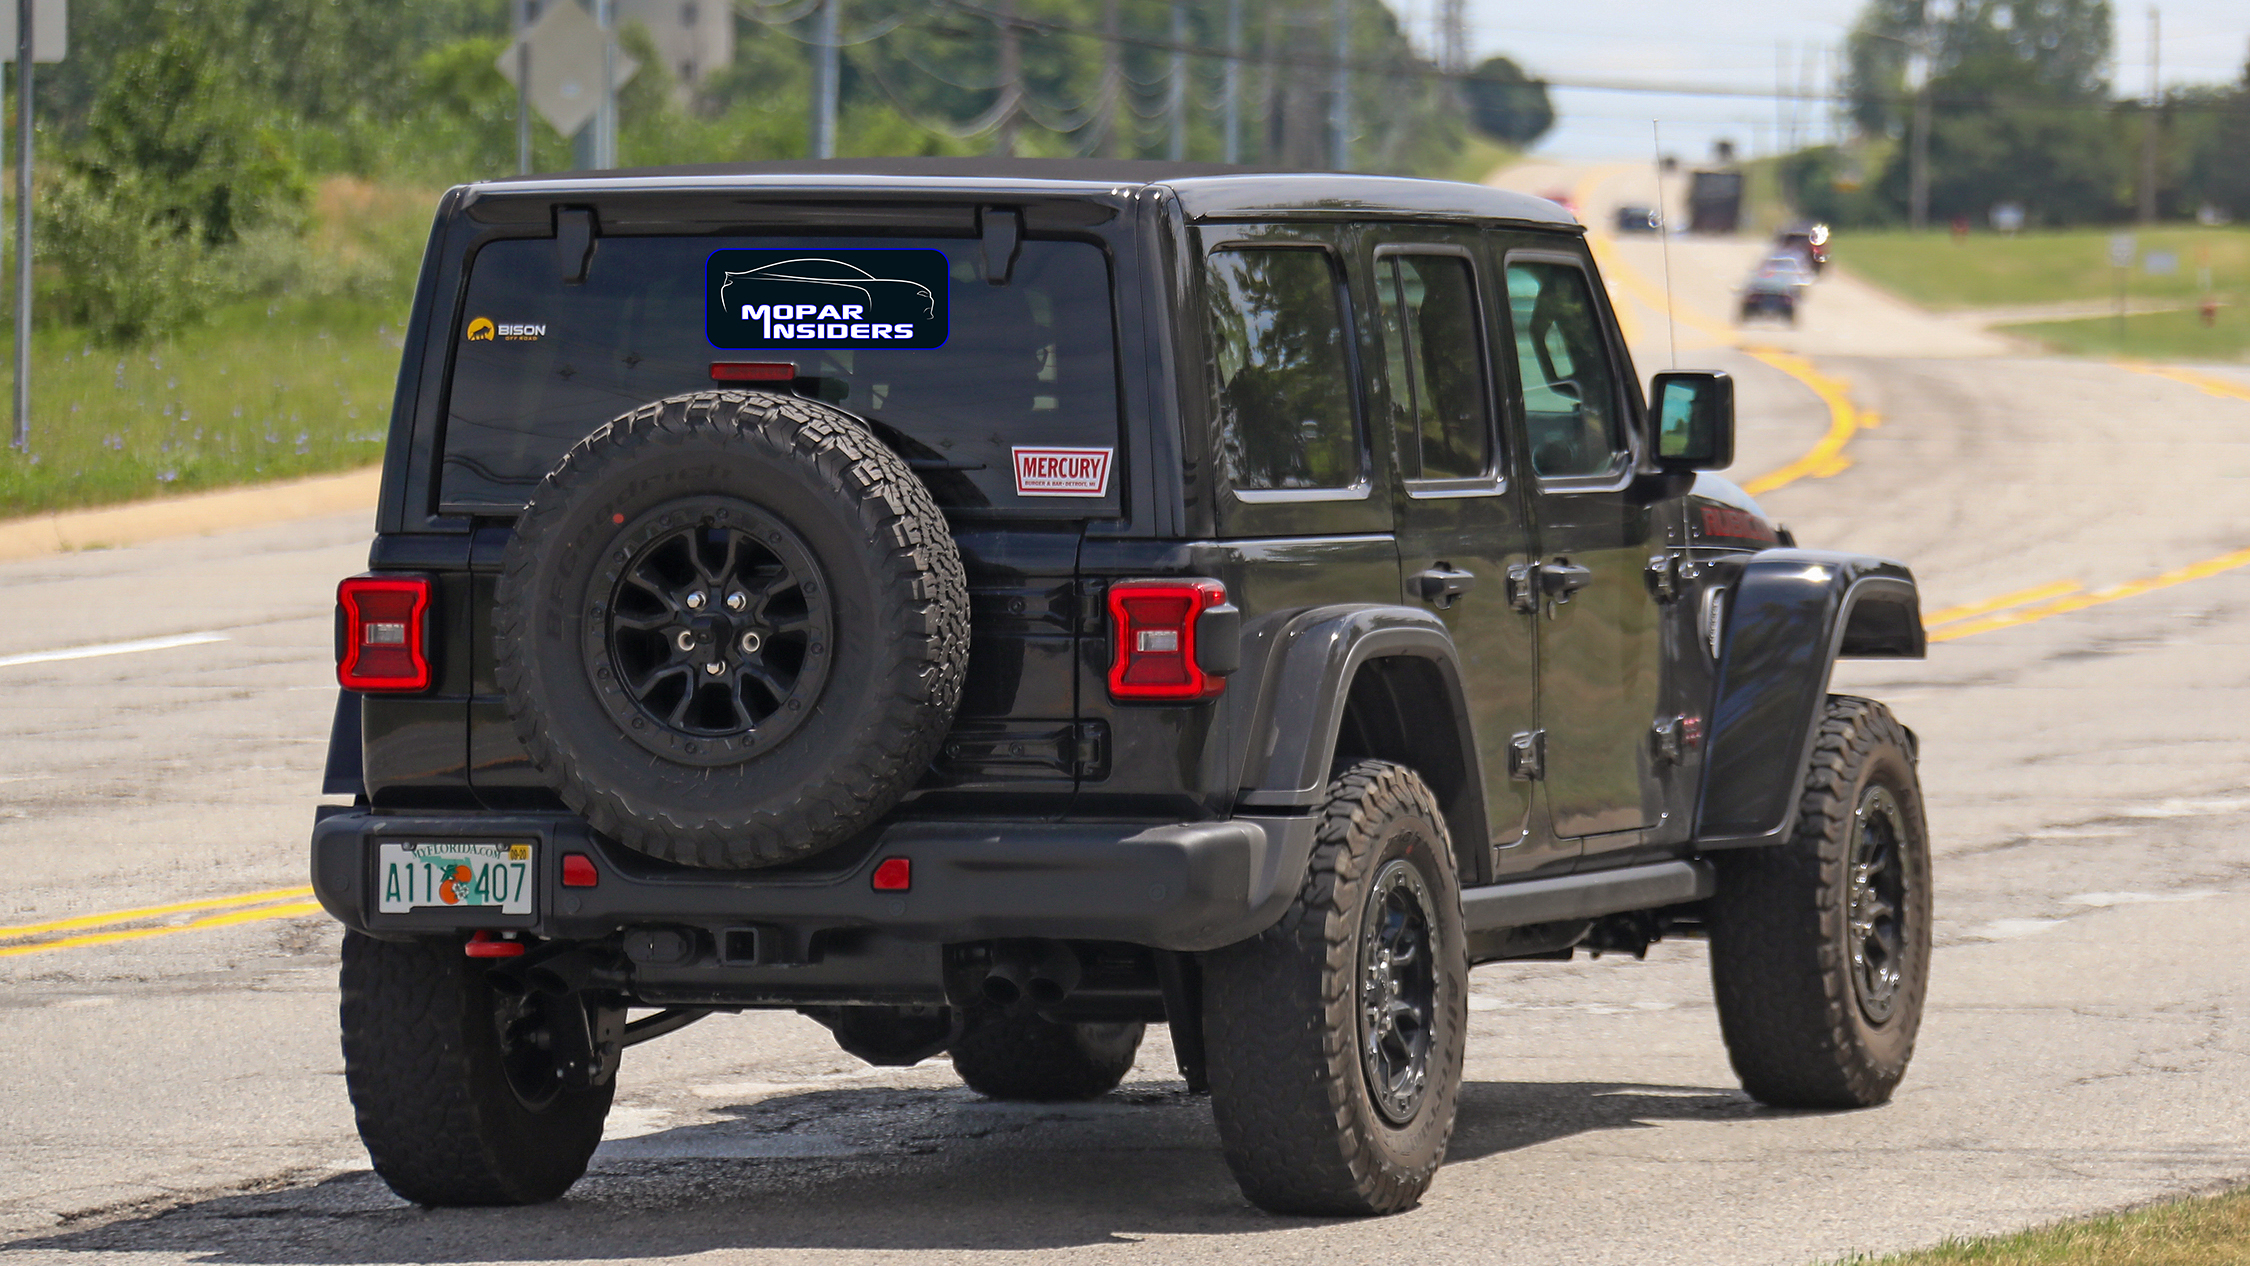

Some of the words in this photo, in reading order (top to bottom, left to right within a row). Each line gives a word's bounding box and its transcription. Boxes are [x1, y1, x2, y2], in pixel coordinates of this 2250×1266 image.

[497, 324, 547, 336] BISON
[1023, 457, 1101, 479] MERCURY
[385, 862, 432, 902] A11
[474, 862, 526, 902] 407
